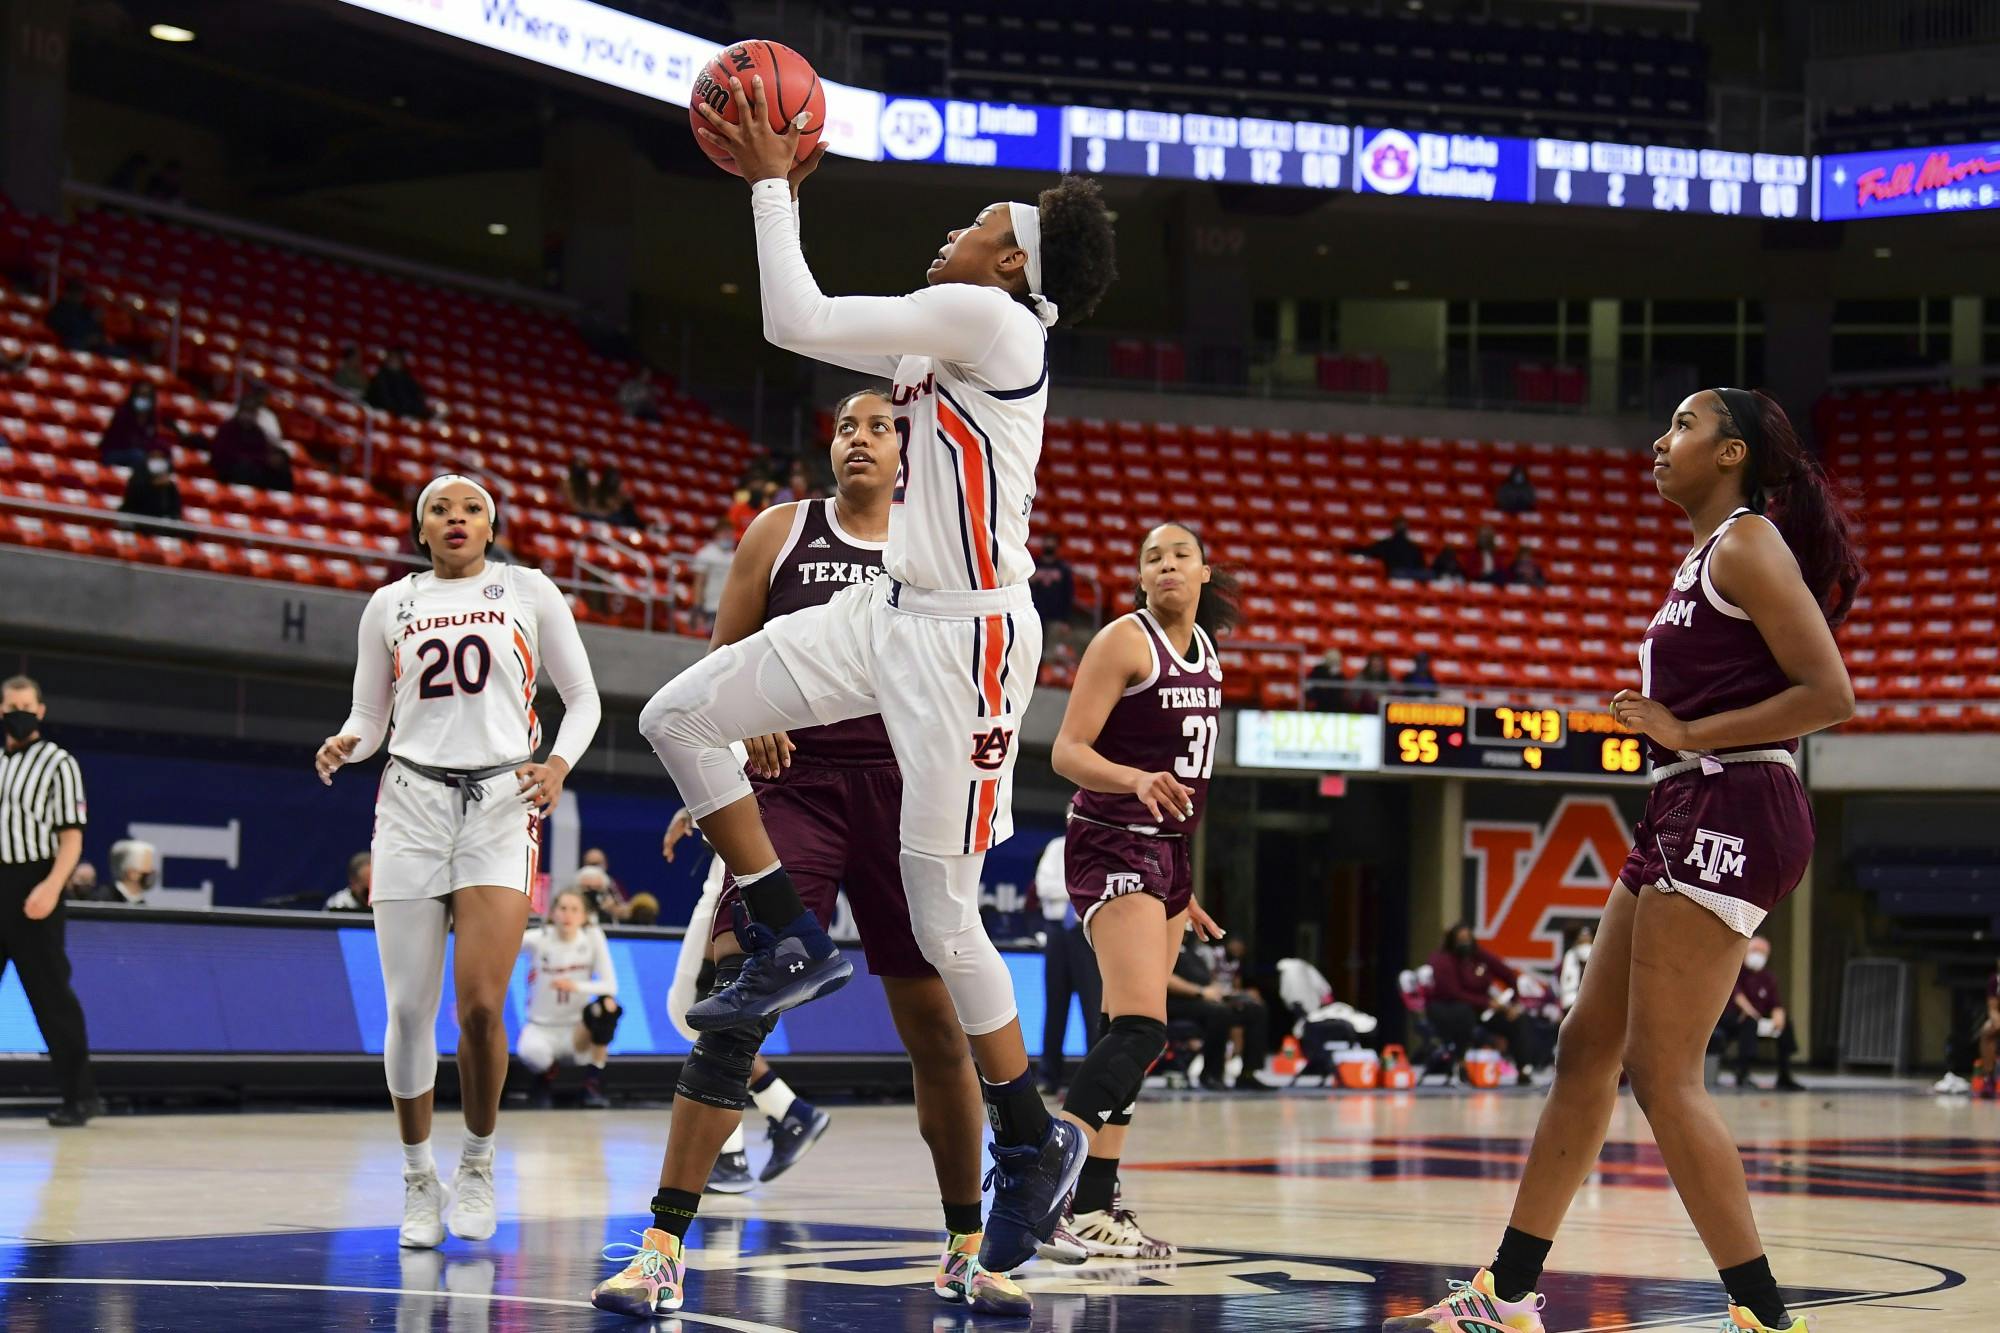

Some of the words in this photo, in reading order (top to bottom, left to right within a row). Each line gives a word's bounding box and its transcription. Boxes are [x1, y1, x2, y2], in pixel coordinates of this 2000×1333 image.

[798, 562, 881, 586] TEXAS
[282, 600, 306, 643] H
[403, 611, 506, 640] AUBURN
[416, 634, 491, 700] 20
[1158, 687, 1207, 709] TEXAS
[1495, 707, 1560, 743] 7:43
[1173, 715, 1219, 780] 31
[1398, 728, 1438, 763] 55
[1601, 737, 1641, 772] 66
